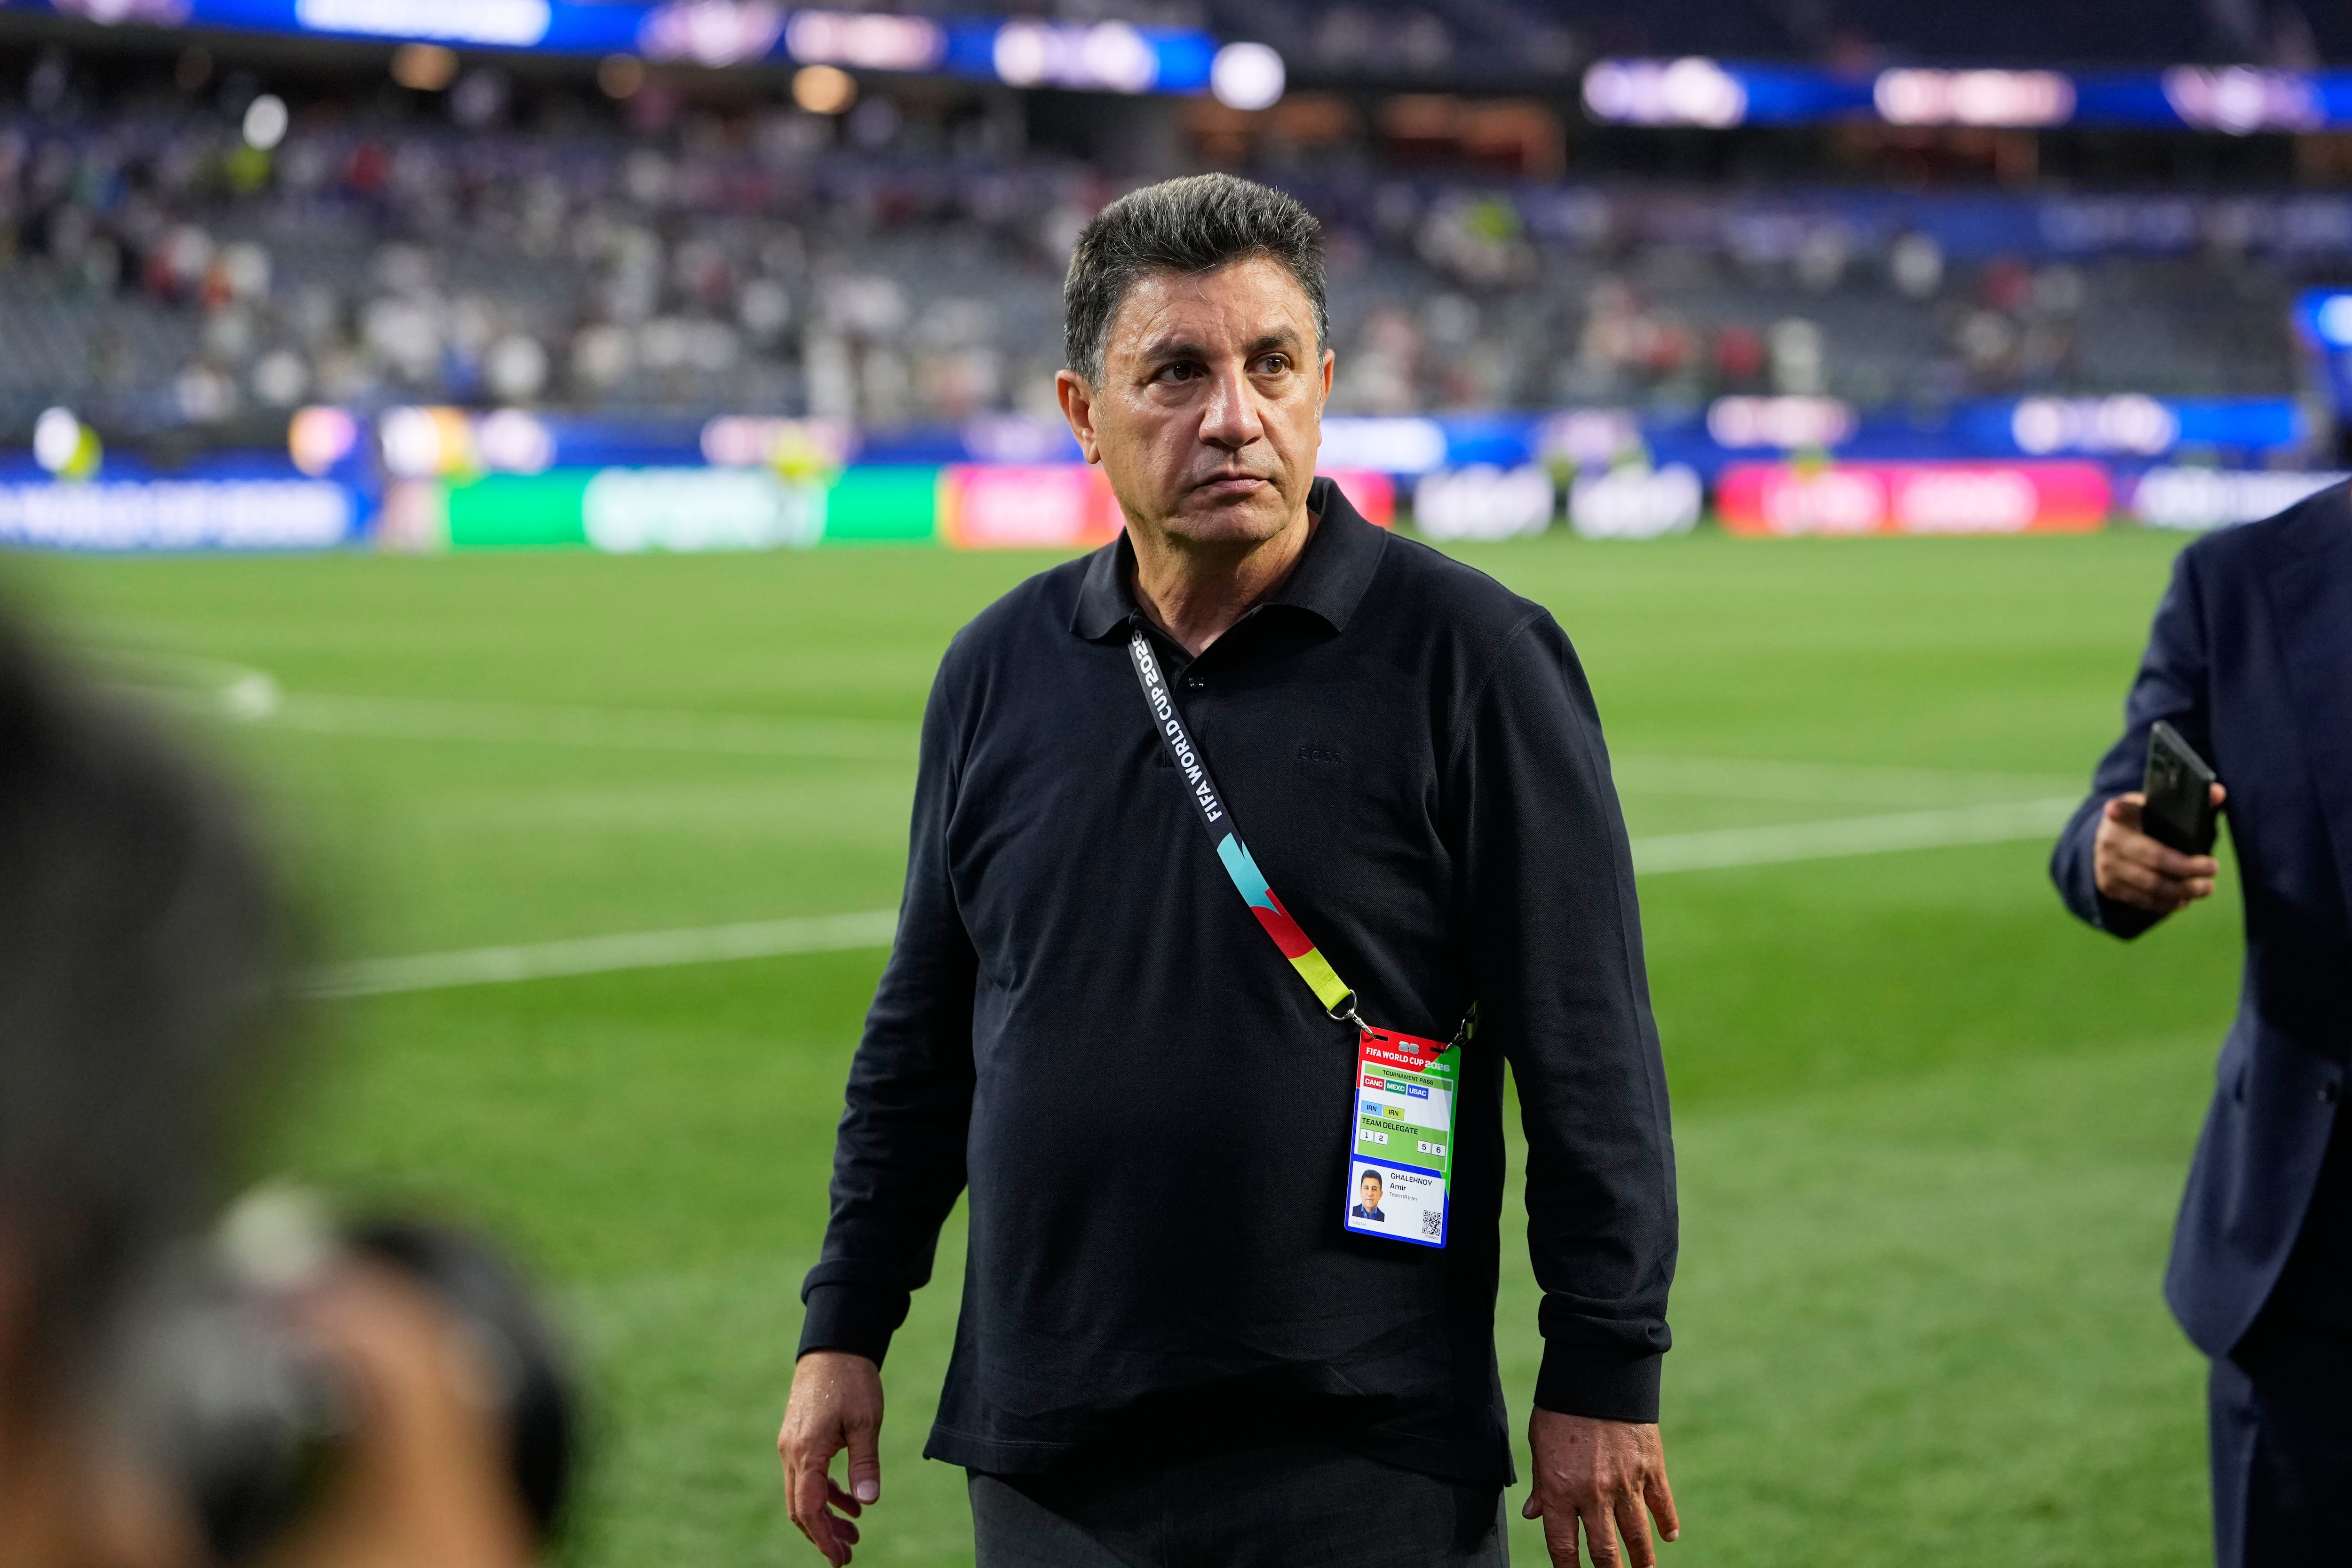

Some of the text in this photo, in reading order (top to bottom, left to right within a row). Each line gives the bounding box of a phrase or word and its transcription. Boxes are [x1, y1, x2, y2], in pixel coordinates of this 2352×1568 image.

[1131, 629, 1222, 822] FIFA WORLD CUP 2026
[1366, 1047, 1450, 1072] FIFA WORLD CUP 2026
[1383, 1070, 1419, 1082] TOURNAMENT
[1365, 1078, 1427, 1097] CANC MEXC USAC
[1362, 1117, 1418, 1135] TEAM DELEGATE
[1391, 1173, 1432, 1186] GHALEHNOY
